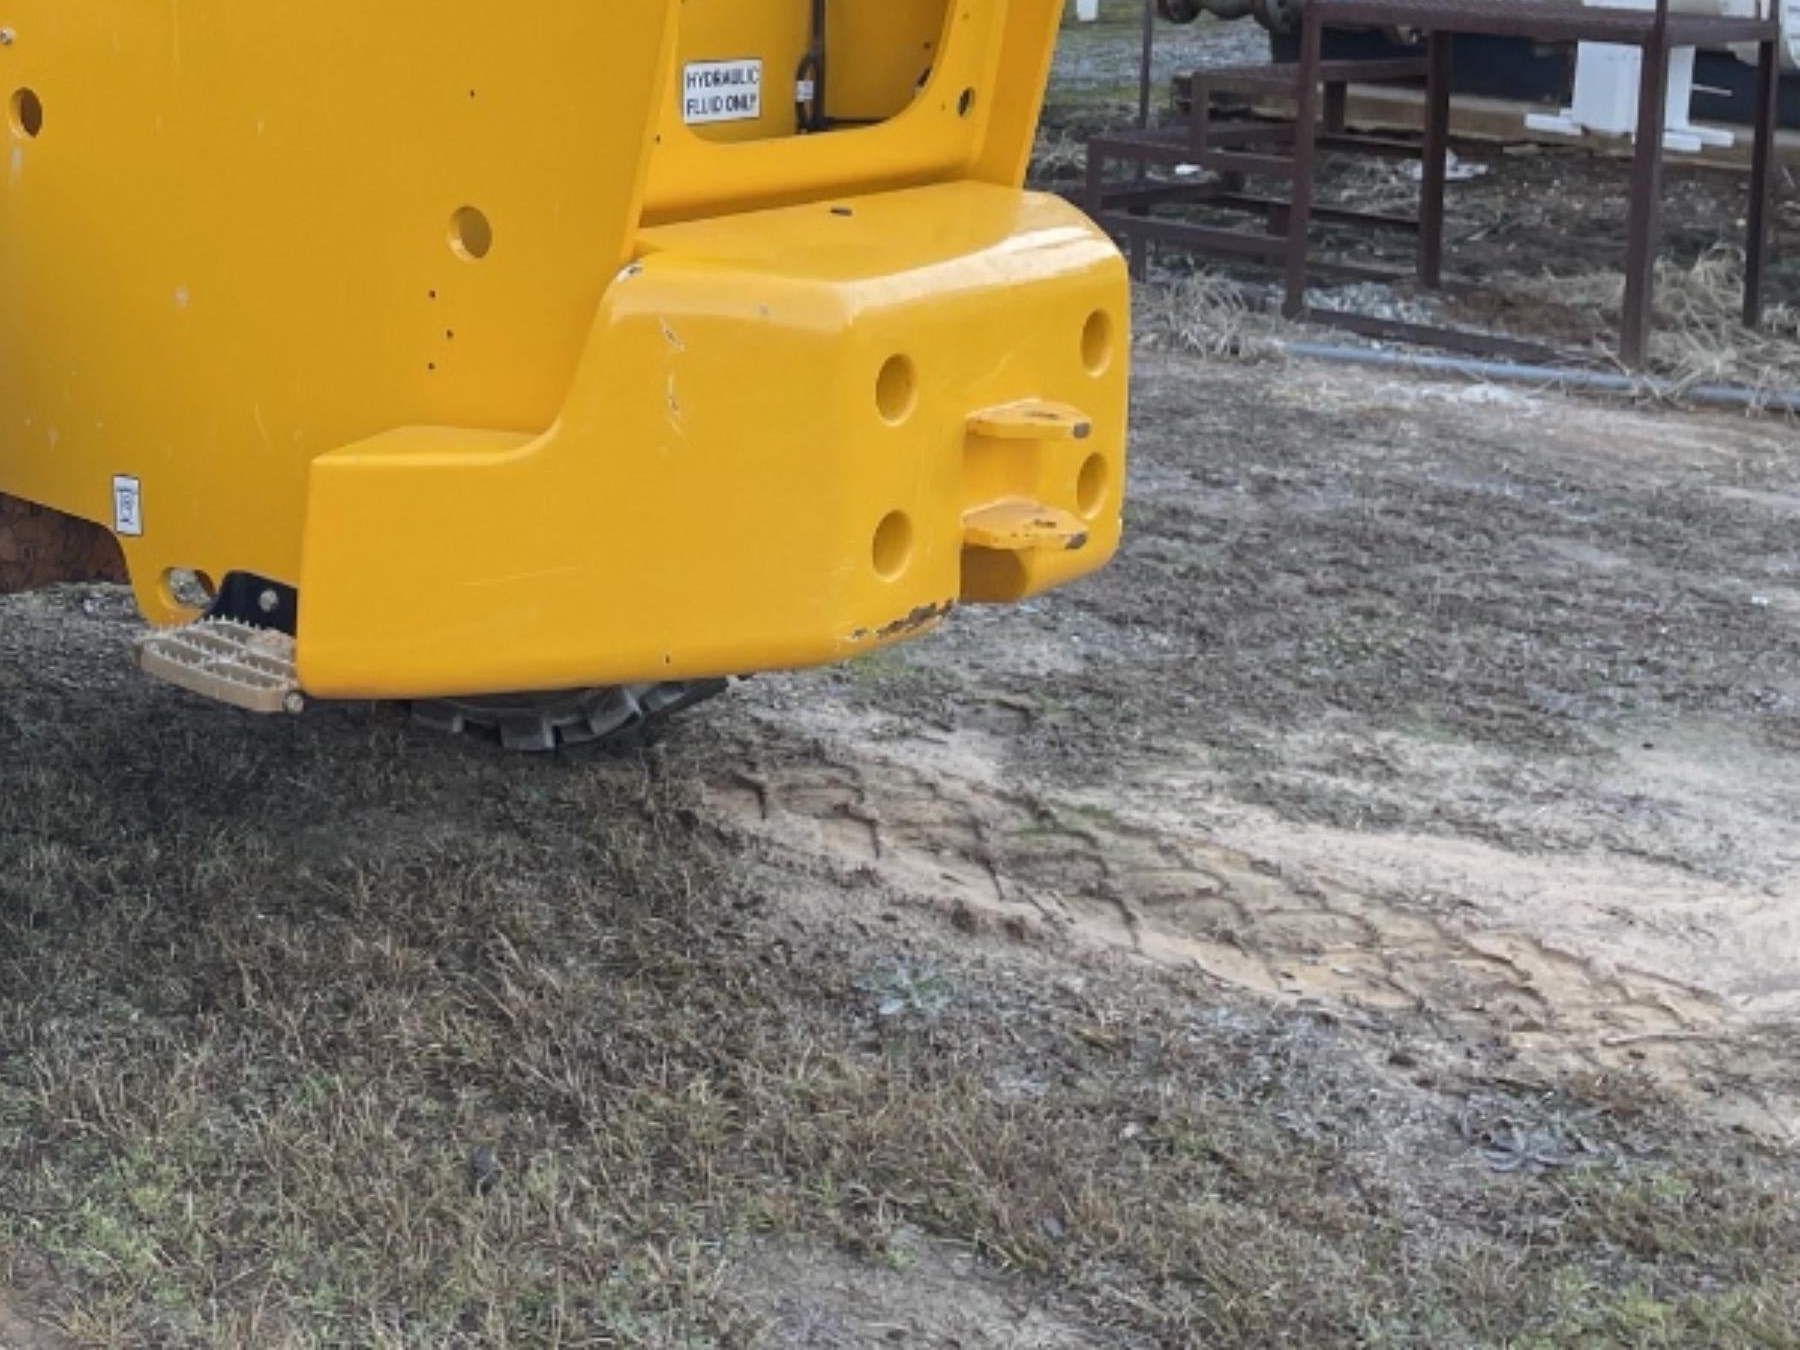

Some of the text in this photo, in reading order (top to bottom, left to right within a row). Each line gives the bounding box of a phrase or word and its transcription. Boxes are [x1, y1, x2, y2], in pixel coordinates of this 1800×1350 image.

[686, 65, 759, 89] HYDRAULIC
[686, 93, 757, 116] FLUID ONLY
